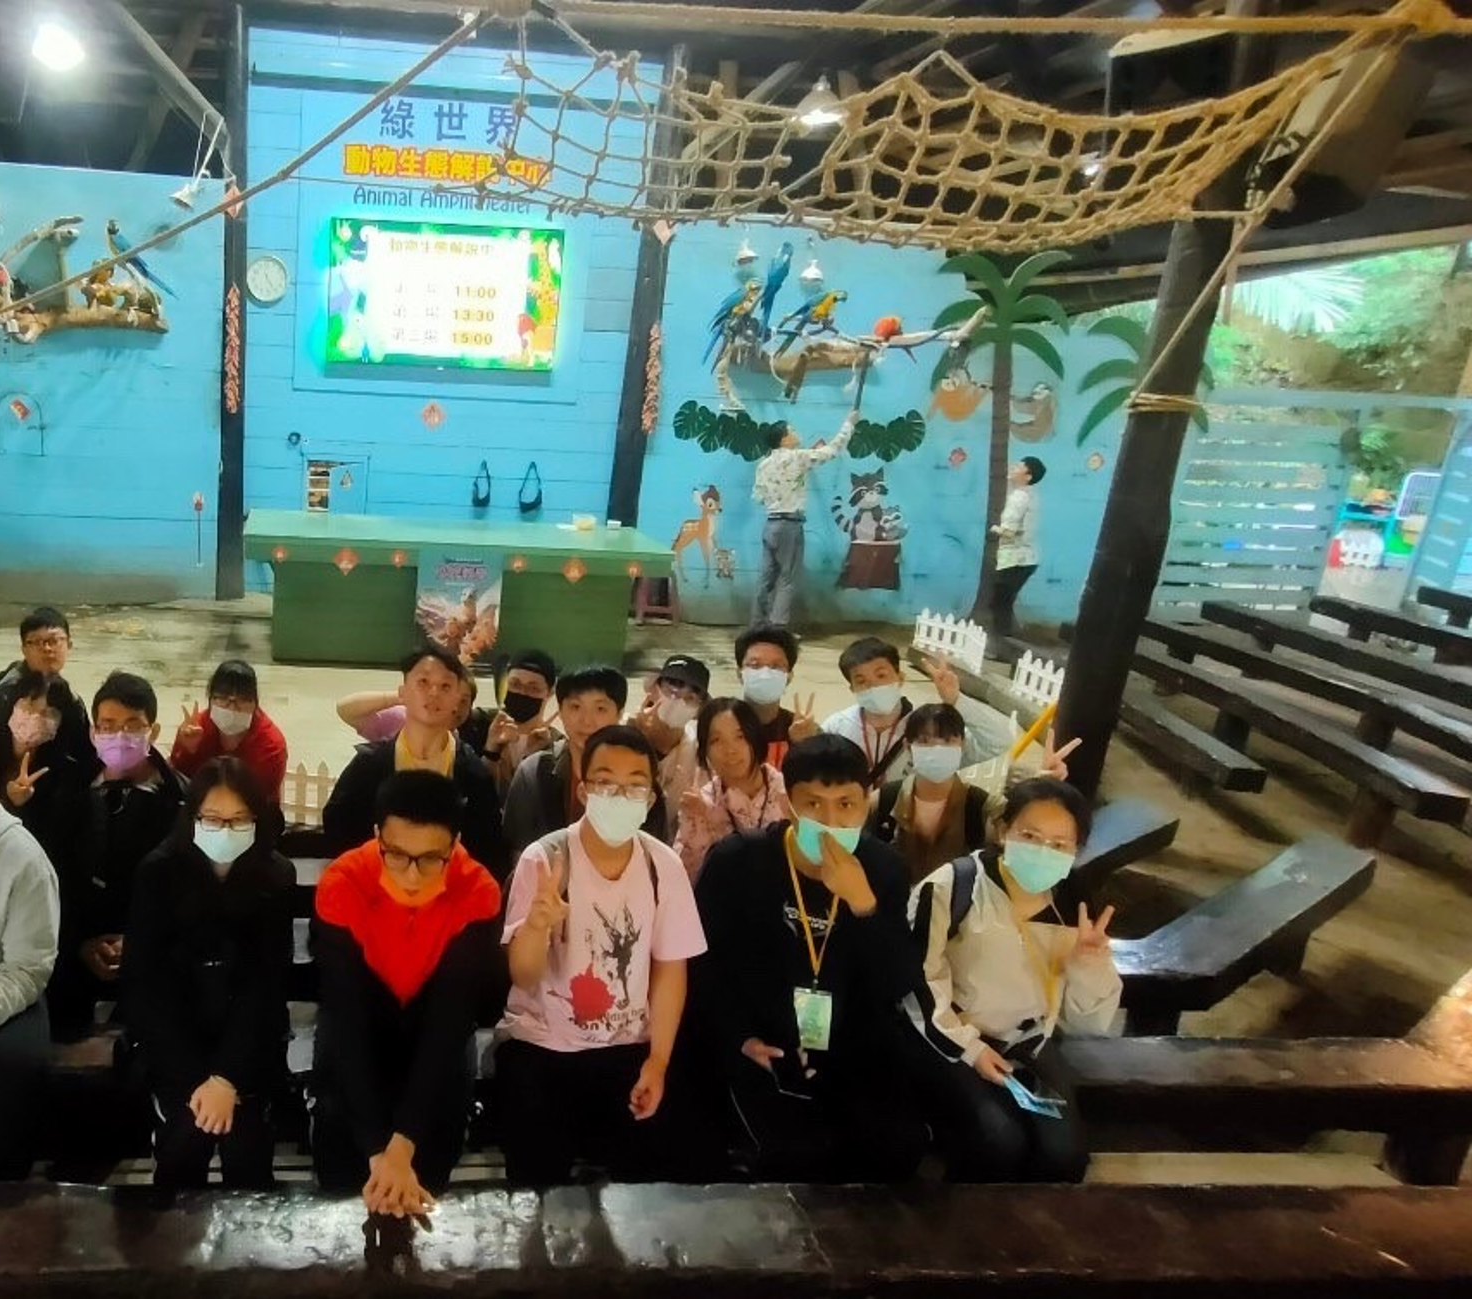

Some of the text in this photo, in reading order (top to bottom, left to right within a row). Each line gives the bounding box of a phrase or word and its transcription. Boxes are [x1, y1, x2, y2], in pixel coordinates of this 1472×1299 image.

[380, 100, 517, 144] 綠世界
[354, 186, 412, 207] Animal
[454, 308, 495, 322] 13:30
[452, 332, 493, 346] 15:00
